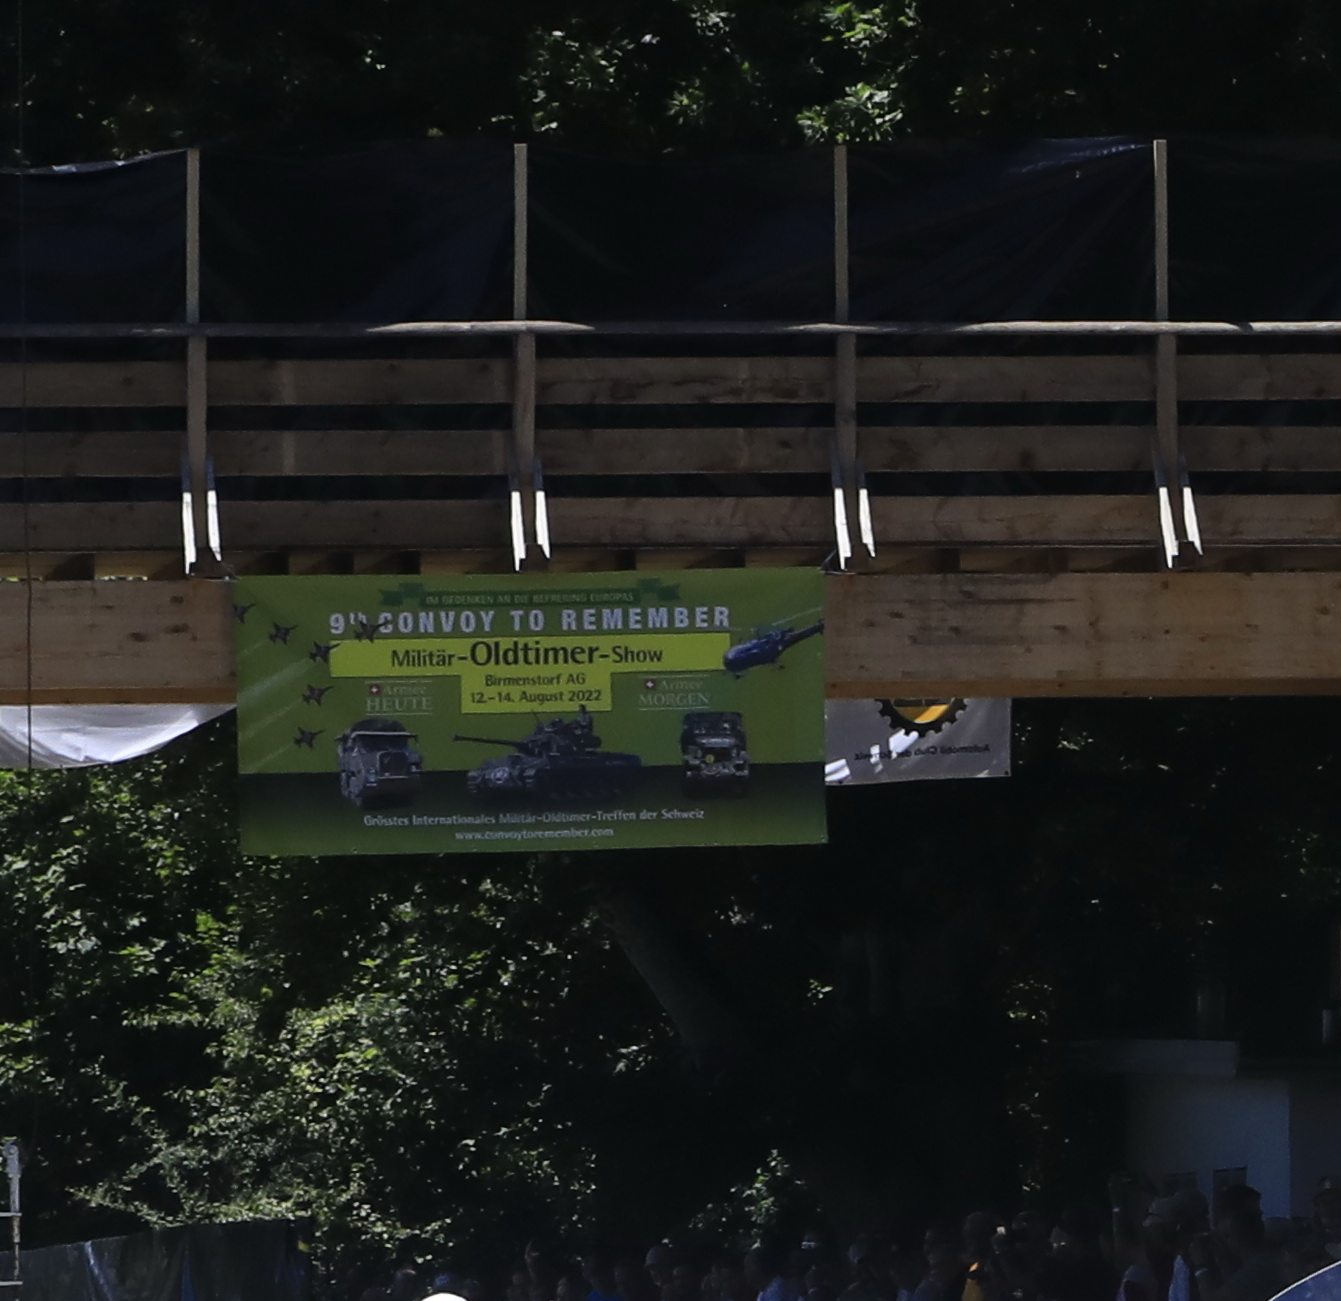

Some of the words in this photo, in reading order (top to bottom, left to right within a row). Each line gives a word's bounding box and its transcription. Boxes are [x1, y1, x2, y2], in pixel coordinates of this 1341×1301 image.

[378, 610, 496, 635] CONVOY
[510, 609, 545, 632] TO
[561, 606, 730, 631] REMEMBER
[391, 640, 664, 668] Militär-Oldtimer-Show
[485, 673, 562, 688] Birmenstorf
[566, 672, 586, 685] AG
[365, 697, 433, 712] HEUTE
[519, 689, 564, 705] August
[568, 689, 603, 702] 2022
[639, 692, 711, 706] MORGEN
[363, 814, 409, 827] Grösstes
[412, 813, 496, 826] Internationales
[639, 808, 658, 821] der
[661, 808, 705, 820] Schweiz
[455, 827, 614, 841] www.convoytoremember.com
